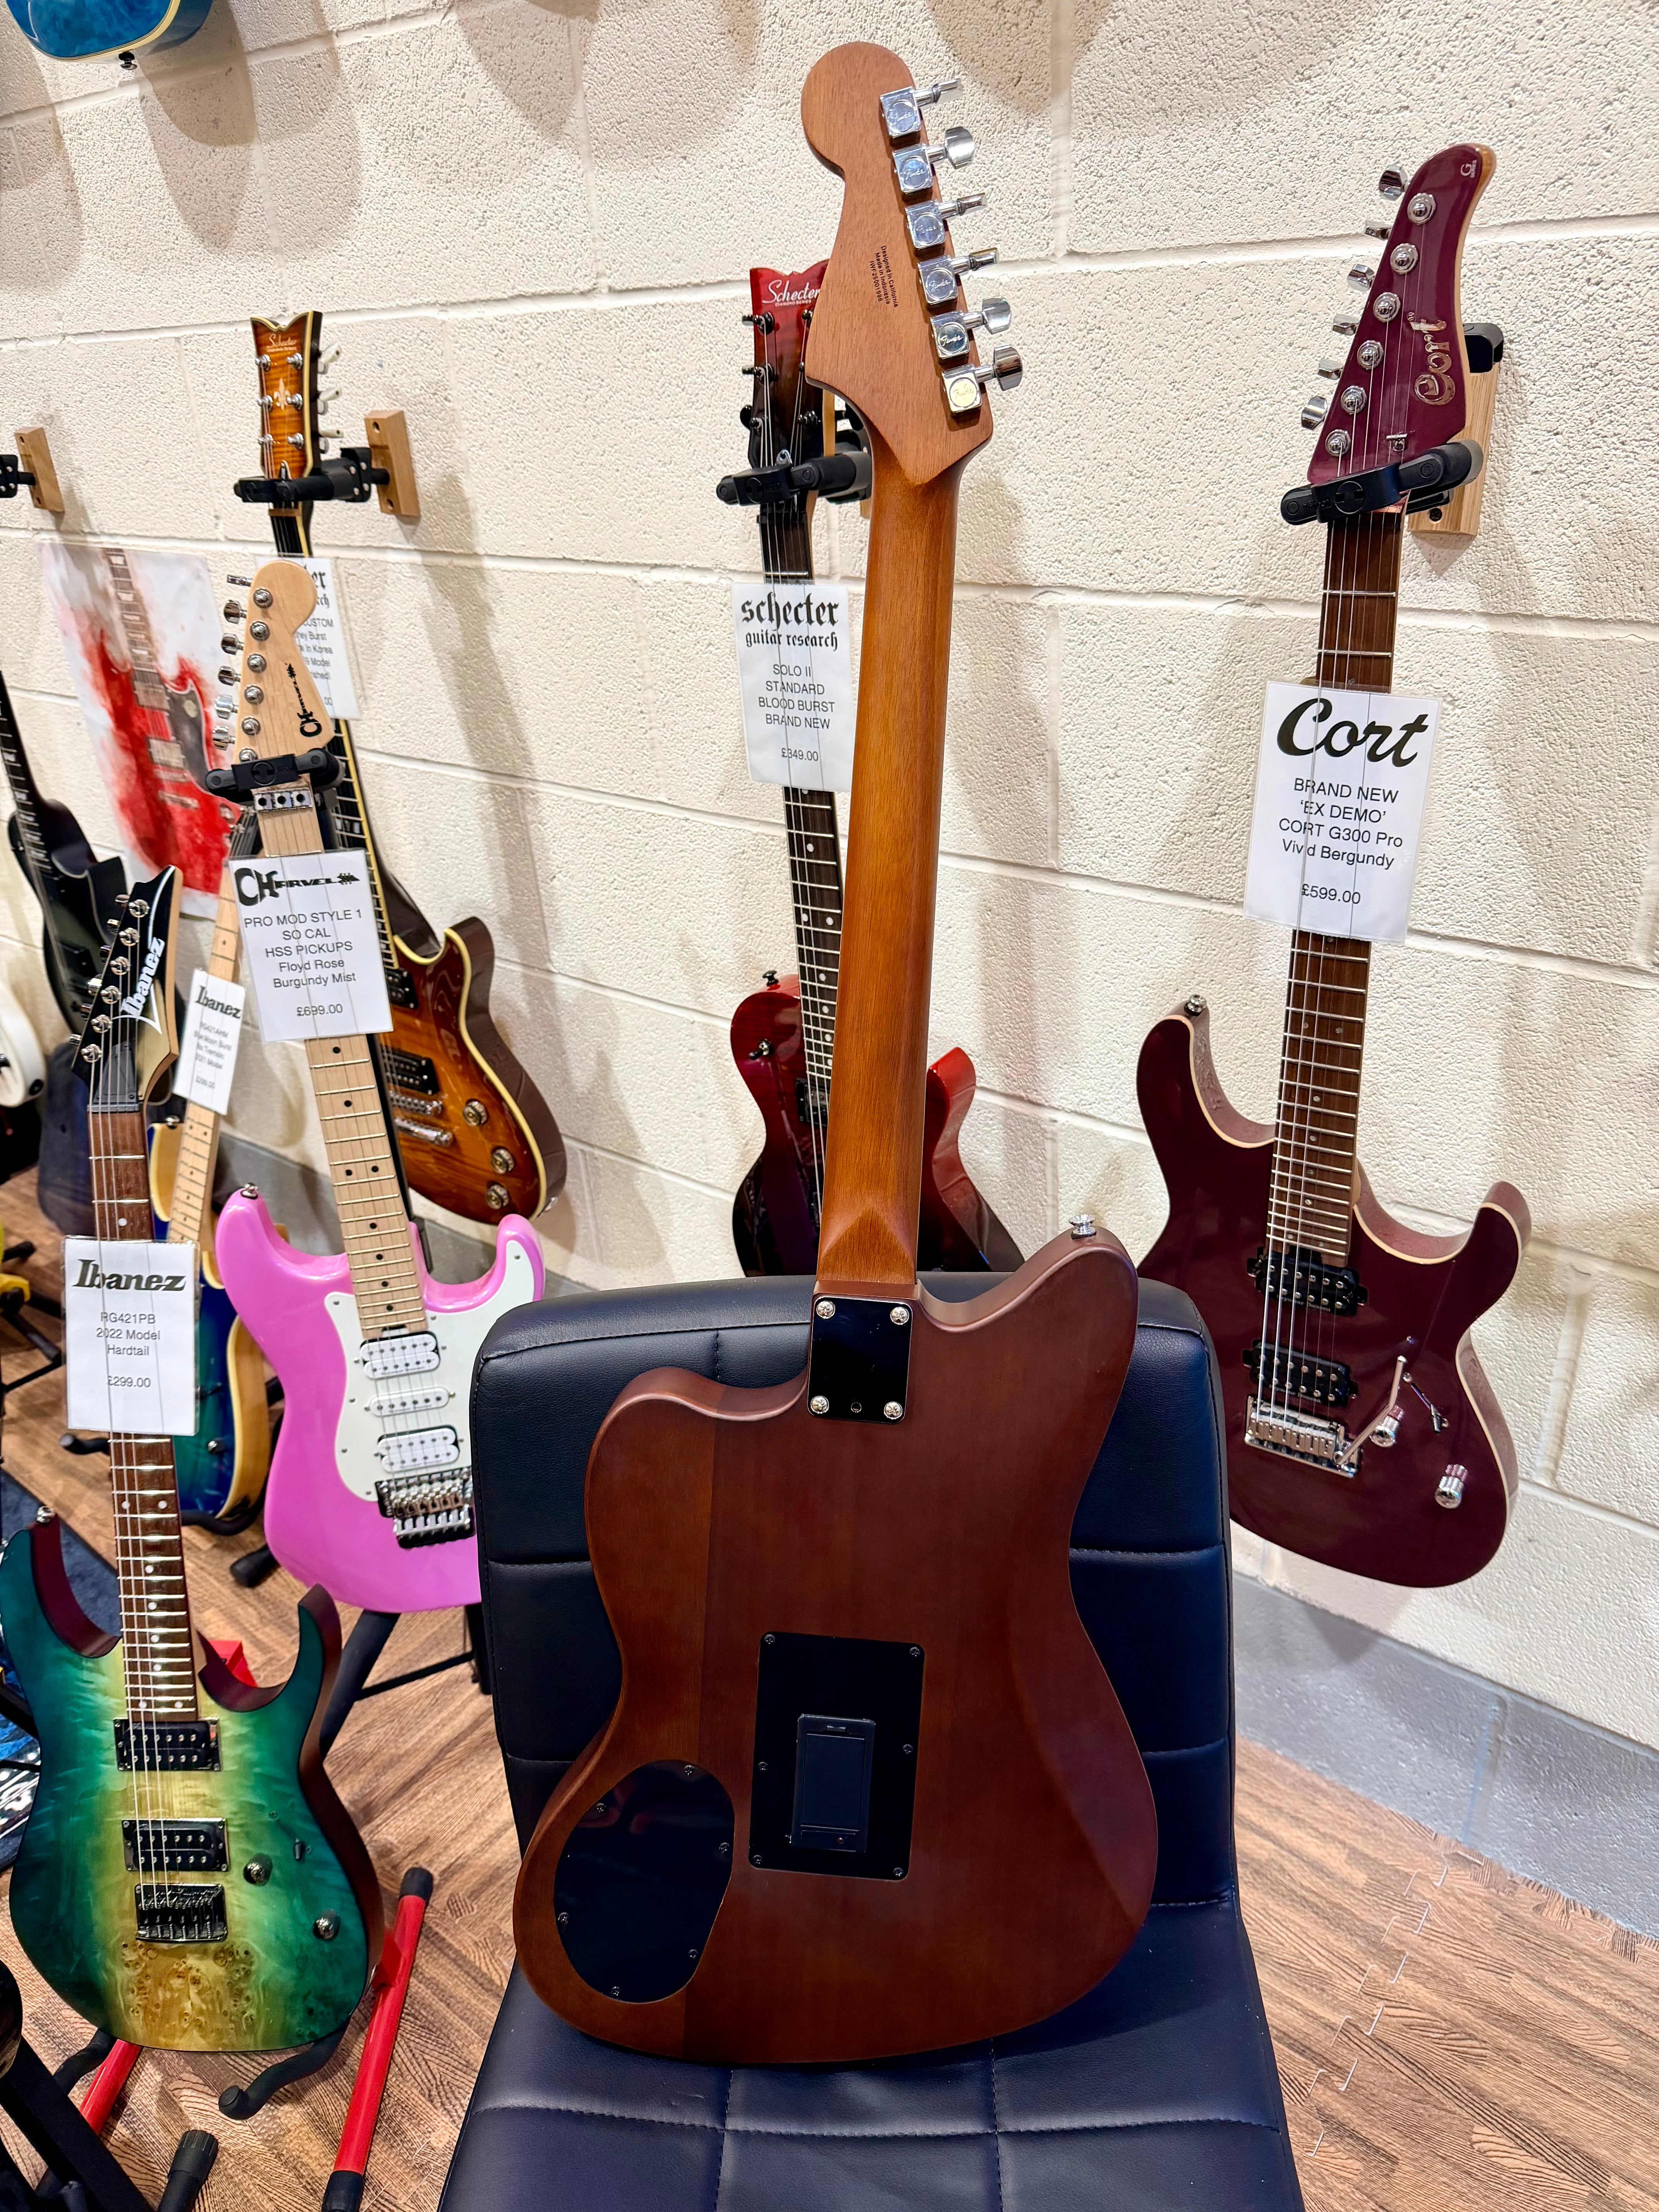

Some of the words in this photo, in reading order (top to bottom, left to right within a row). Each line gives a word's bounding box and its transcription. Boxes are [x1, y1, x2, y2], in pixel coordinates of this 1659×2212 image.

[881, 246, 891, 273] Designed
[889, 279, 898, 307] California
[762, 279, 821, 304] Schecter
[880, 275, 891, 305] Indonesia
[1410, 319, 1456, 405] Cort
[741, 591, 839, 630] schecter
[745, 629, 782, 647] guitar
[787, 632, 838, 652] research
[773, 664, 802, 678] SOLO
[805, 666, 811, 678] II
[765, 680, 825, 695] STANDARD
[758, 697, 795, 710] BLOOD
[798, 700, 835, 713] BURST
[765, 714, 802, 728] BRAND
[804, 718, 830, 730] NEW
[1277, 698, 1429, 767] Cort
[1294, 778, 1352, 799] BRAND
[1357, 786, 1399, 804] NEW
[1278, 818, 1324, 838] CORT
[1329, 826, 1370, 844] G300
[1376, 831, 1403, 848] Pro
[1282, 839, 1316, 857] Vivd
[1321, 846, 1395, 870] Bergundy
[1301, 883, 1361, 904] £599.00
[244, 916, 273, 928] PRO
[276, 914, 307, 926] MOD
[311, 909, 352, 924] STYLE
[356, 909, 361, 919] 1
[283, 930, 301, 941] SO
[305, 927, 331, 939] CAL
[265, 946, 292, 958] HSS
[296, 941, 353, 955] PICKUPS
[279, 961, 311, 973] Floyd
[315, 959, 345, 969] Rose
[120, 937, 165, 1017] Ibanez
[273, 974, 328, 988] Burgundy
[332, 972, 356, 983] Mist
[195, 986, 242, 1019] Ibanez
[297, 1003, 343, 1017] £699.00
[72, 1259, 186, 1291] Ibanez
[101, 1312, 156, 1324] RG421PB
[96, 1328, 123, 1339] 2022
[125, 1329, 160, 1340] Model
[107, 1344, 150, 1356] Hardtail
[108, 1376, 151, 1388] £299.00
